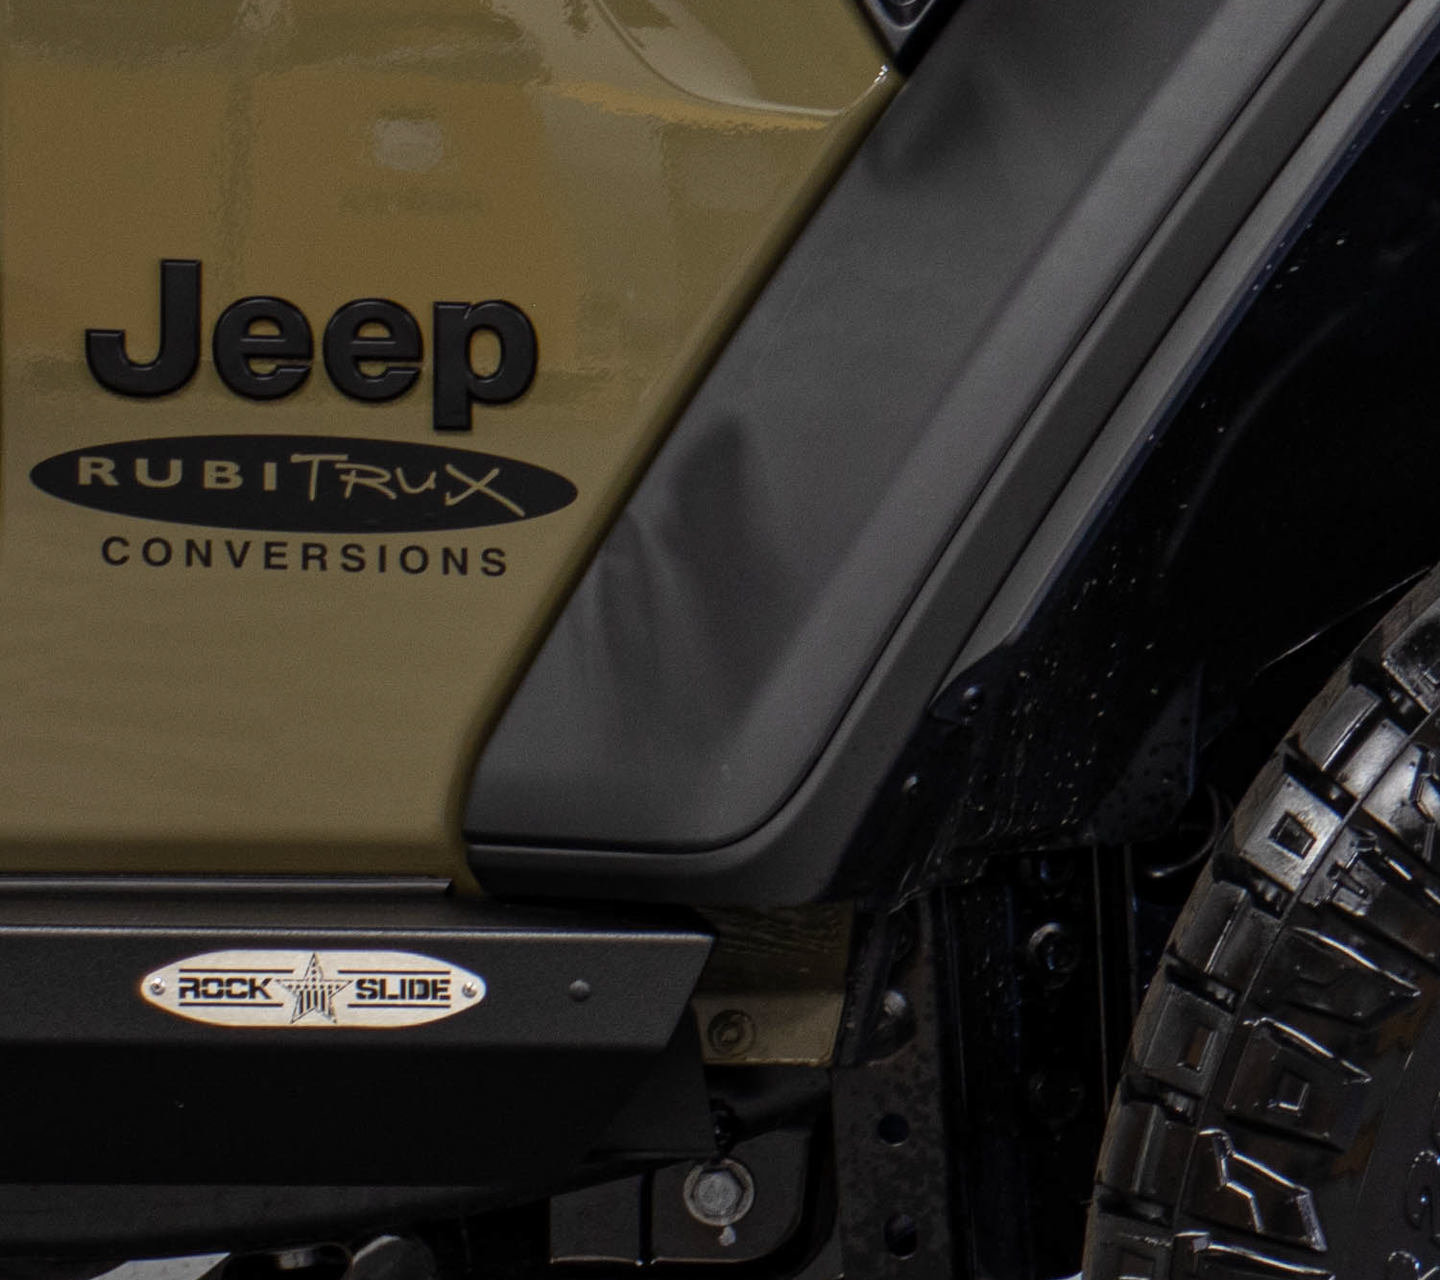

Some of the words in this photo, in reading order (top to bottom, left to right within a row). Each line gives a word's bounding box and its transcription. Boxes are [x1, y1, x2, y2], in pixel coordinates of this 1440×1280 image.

[85, 258, 539, 432] Jeep
[77, 452, 526, 518] RUBITRUX
[101, 536, 508, 577] CONVERSIONS
[178, 976, 273, 1002] ROCK
[355, 976, 452, 1002] SLIDE
